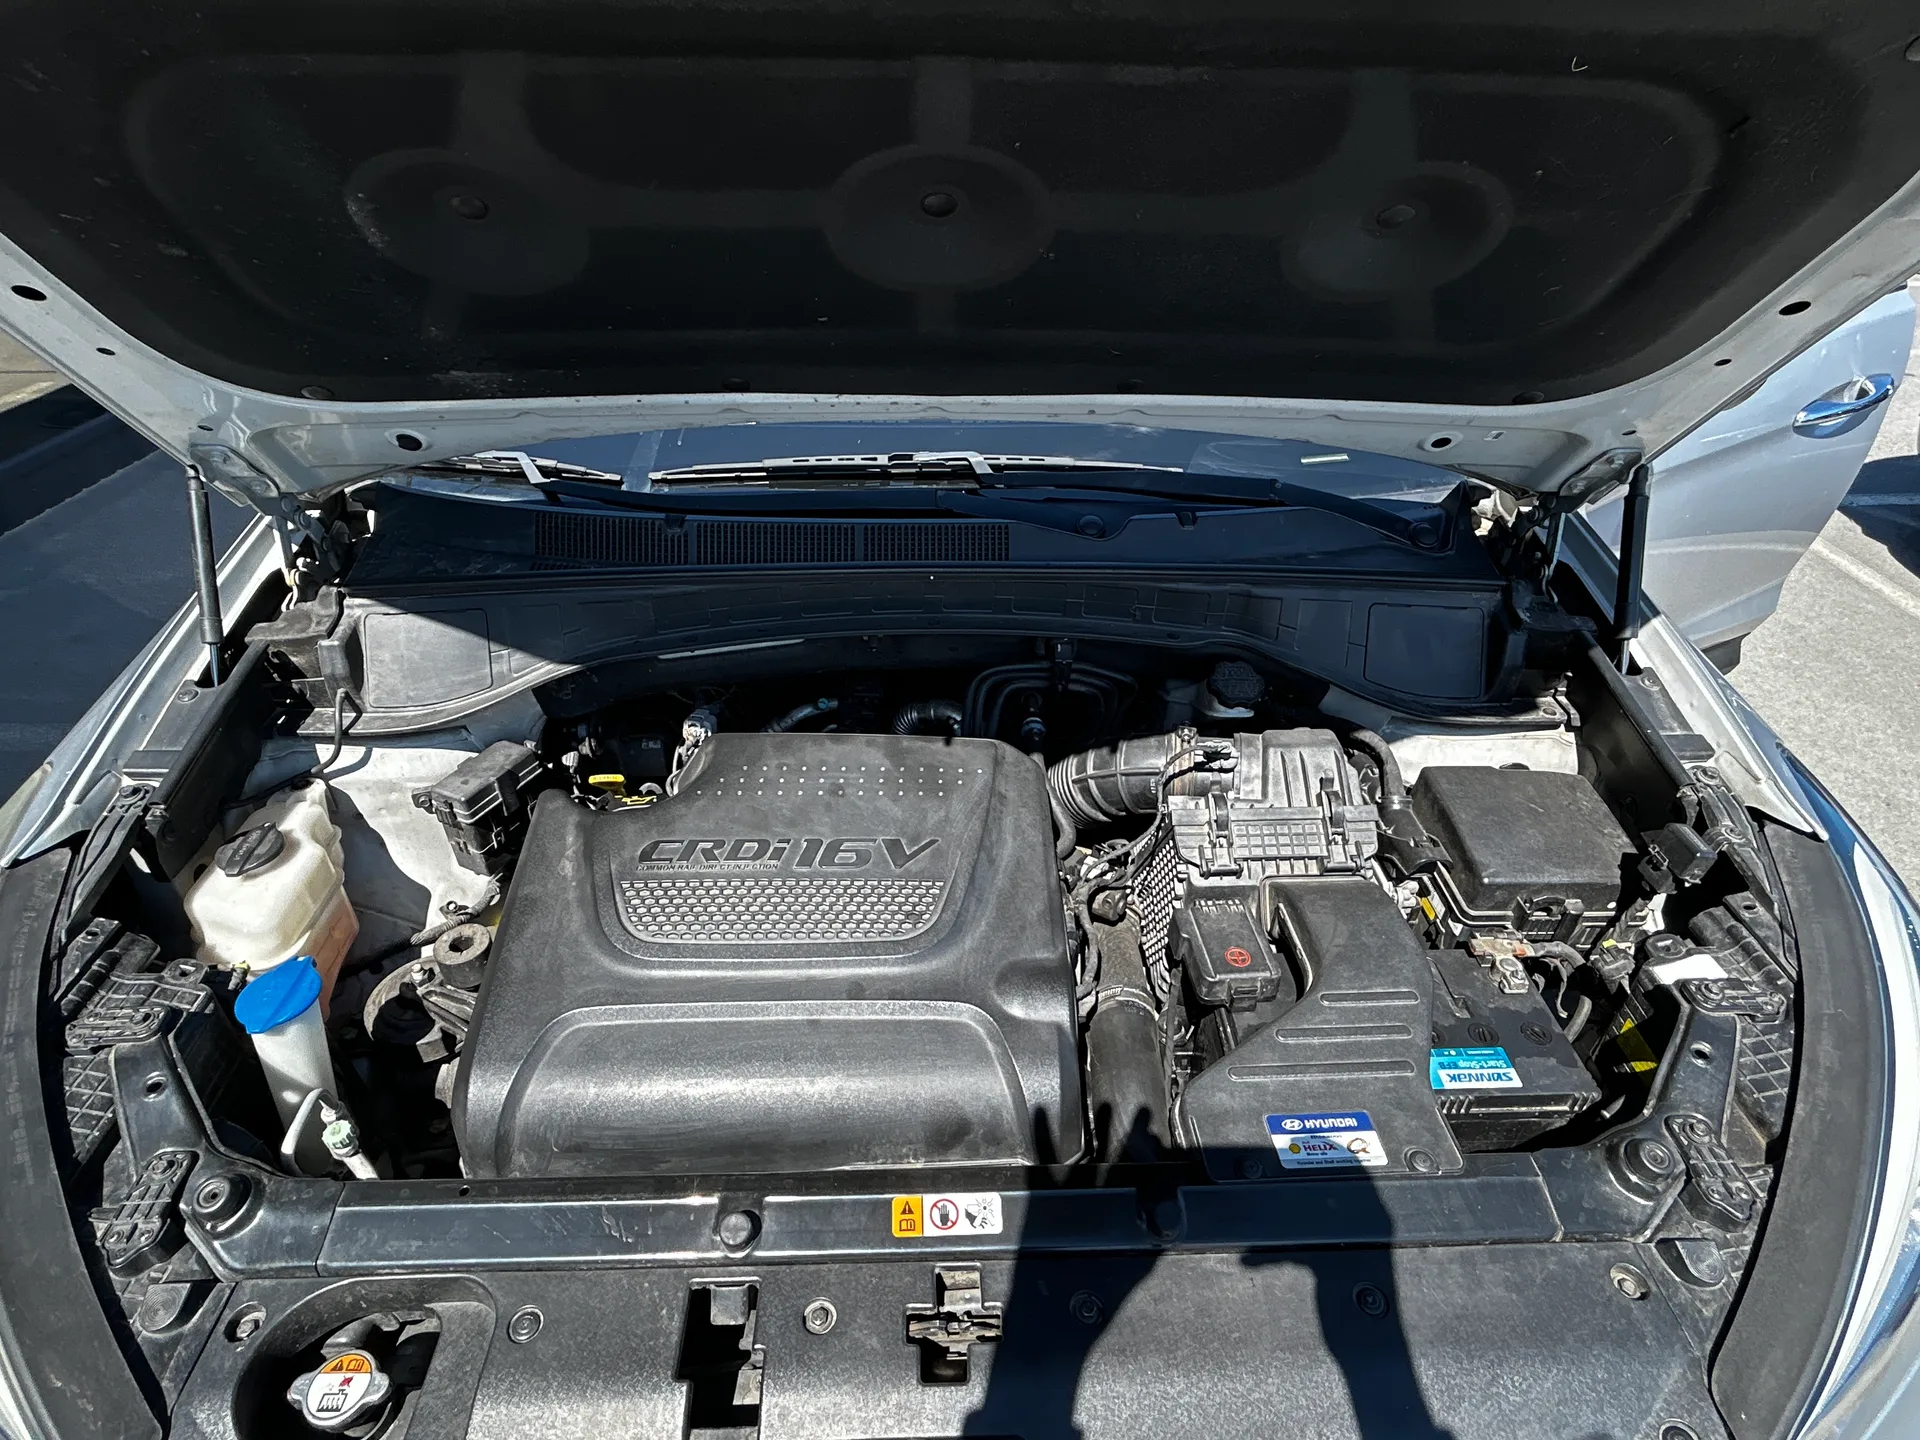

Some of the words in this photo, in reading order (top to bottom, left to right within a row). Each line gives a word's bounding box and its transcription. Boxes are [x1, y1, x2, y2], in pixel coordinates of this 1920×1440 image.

[638, 838, 792, 864] CRDi
[793, 837, 941, 870] 16V
[1438, 1061, 1457, 1070] EFB
[1457, 1059, 1507, 1069] Start-Stop
[1304, 1117, 1358, 1129] HYUNDAI
